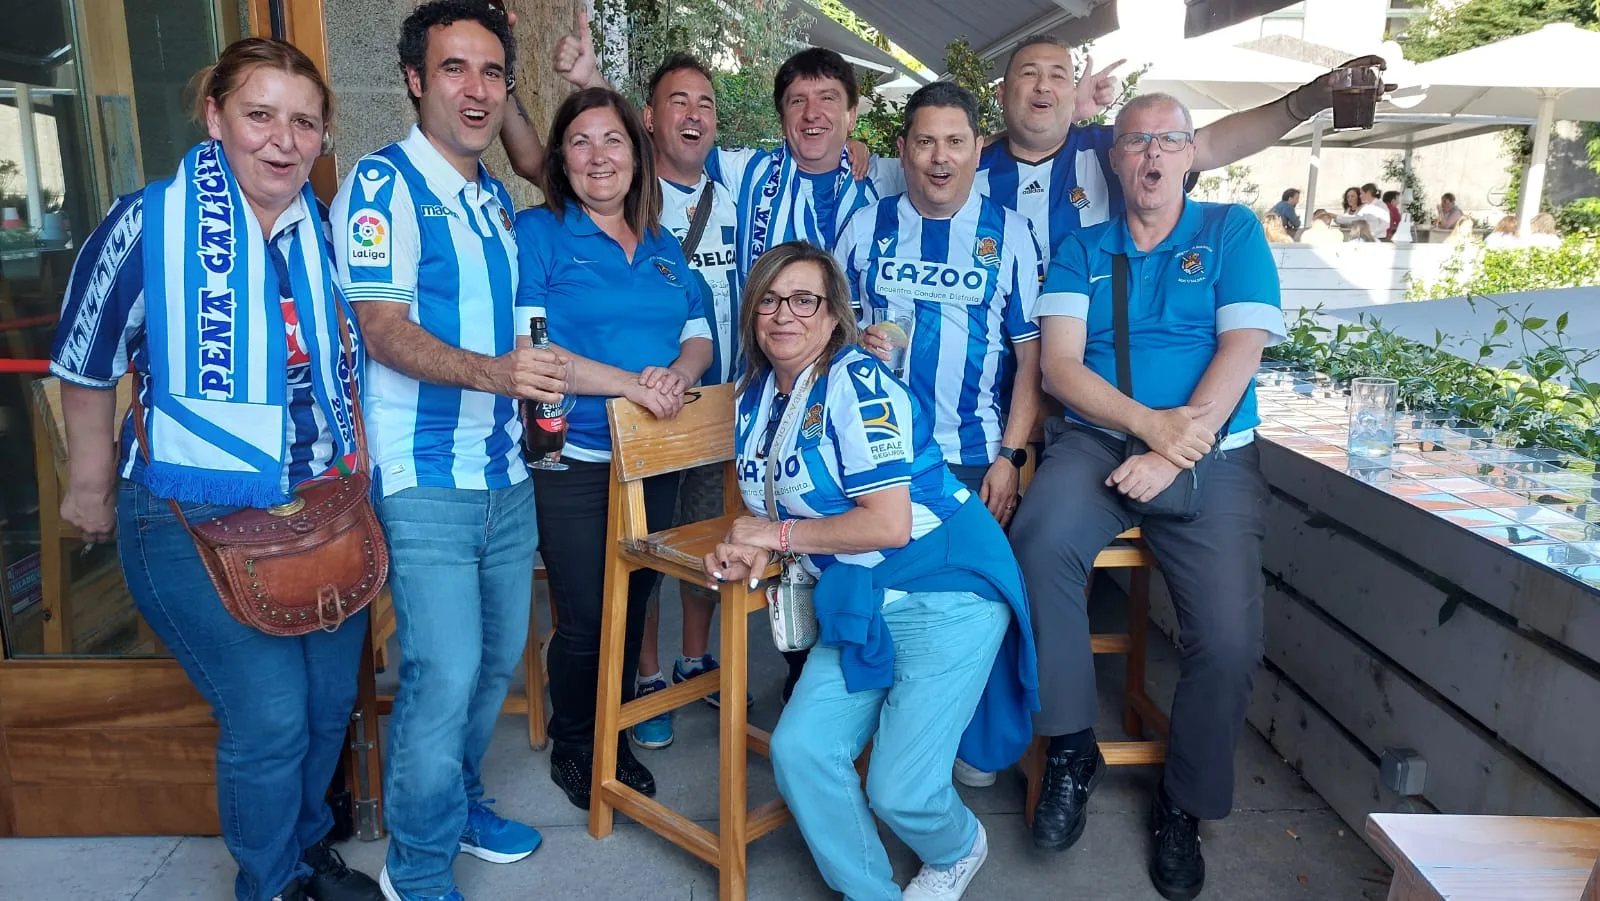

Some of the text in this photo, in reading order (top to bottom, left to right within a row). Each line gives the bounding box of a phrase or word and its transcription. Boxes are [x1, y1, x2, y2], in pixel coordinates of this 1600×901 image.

[352, 249, 386, 260] LaLiga
[881, 261, 983, 290] CAZOO
[870, 441, 902, 454] REALE
